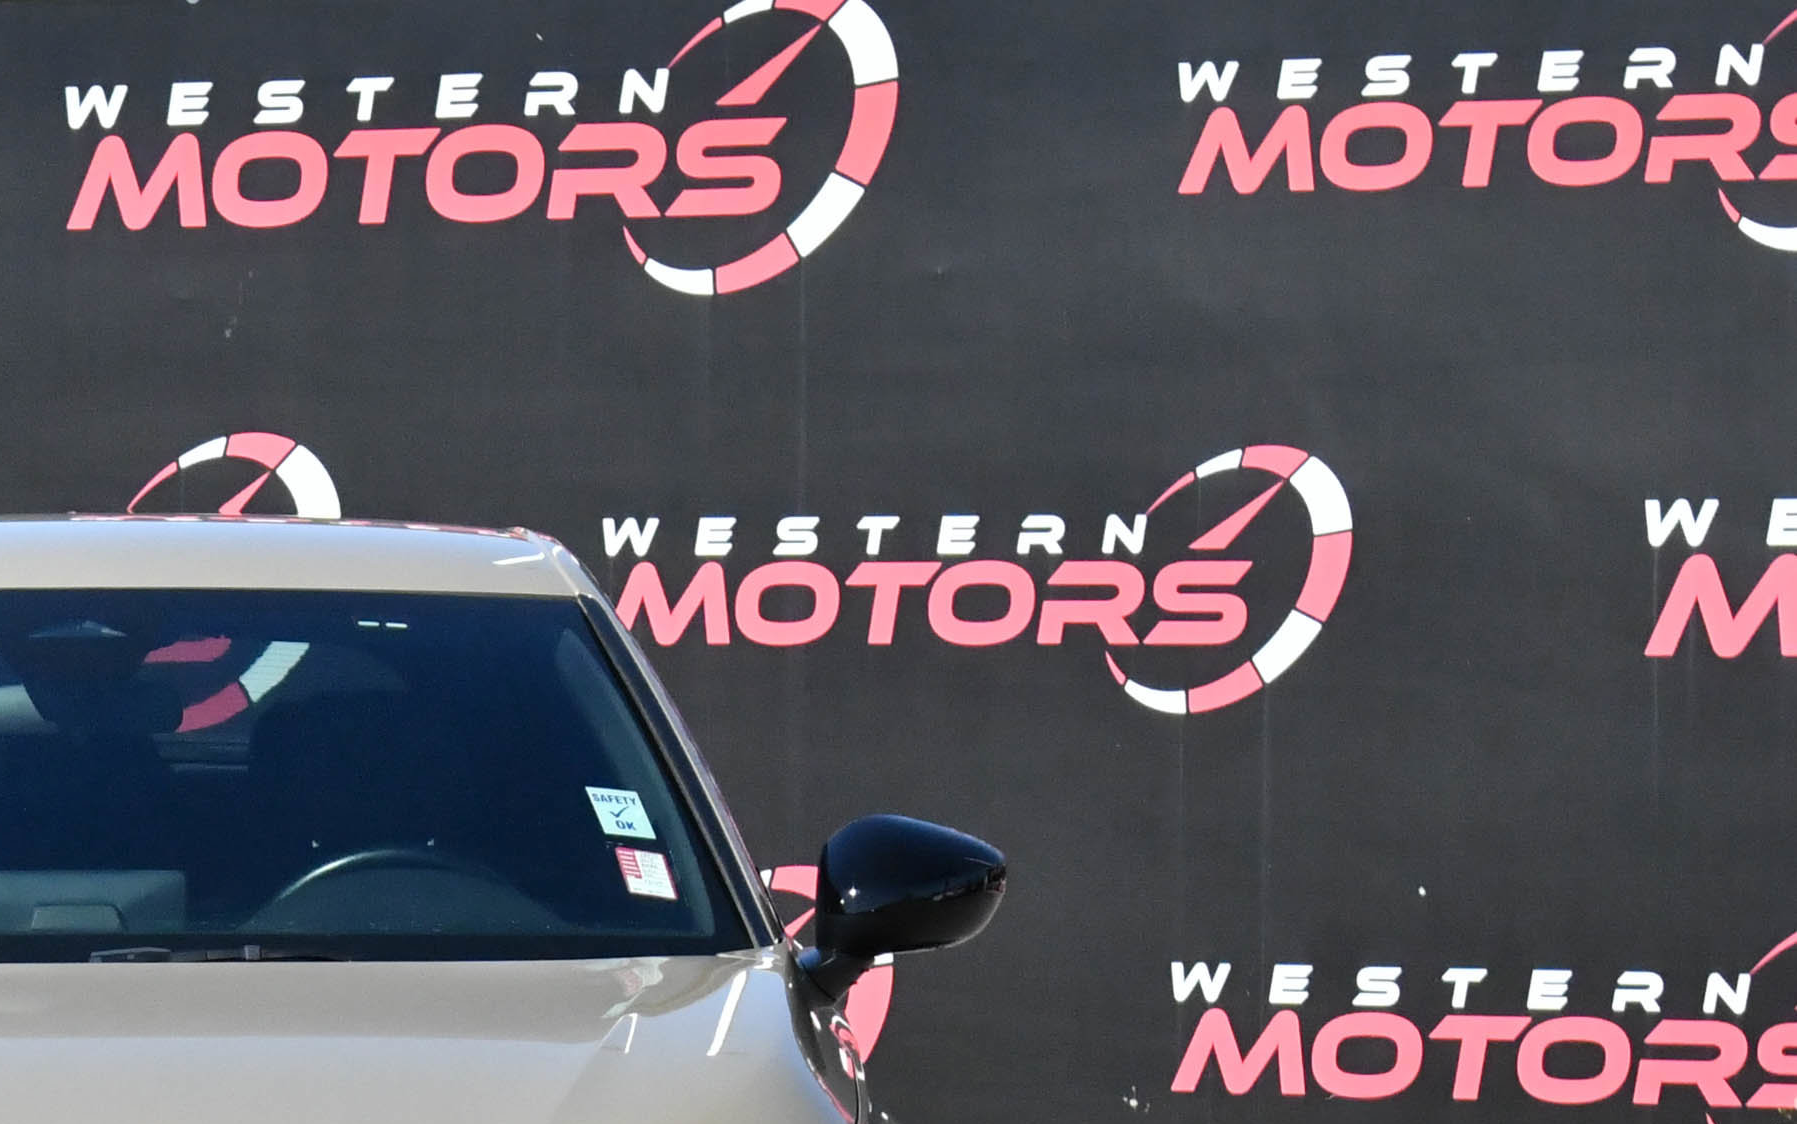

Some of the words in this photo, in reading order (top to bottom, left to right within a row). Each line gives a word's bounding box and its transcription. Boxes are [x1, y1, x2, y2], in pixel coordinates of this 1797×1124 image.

[64, 67, 670, 130] WESTERN
[1178, 43, 1765, 103] WESTERN
[65, 116, 788, 232] MOTORS
[602, 513, 1148, 558] WESTERN
[615, 559, 1254, 647] MOTORS
[592, 793, 636, 805] SAFETY
[615, 820, 636, 831] OK
[1170, 961, 1752, 1016] WESTERN
